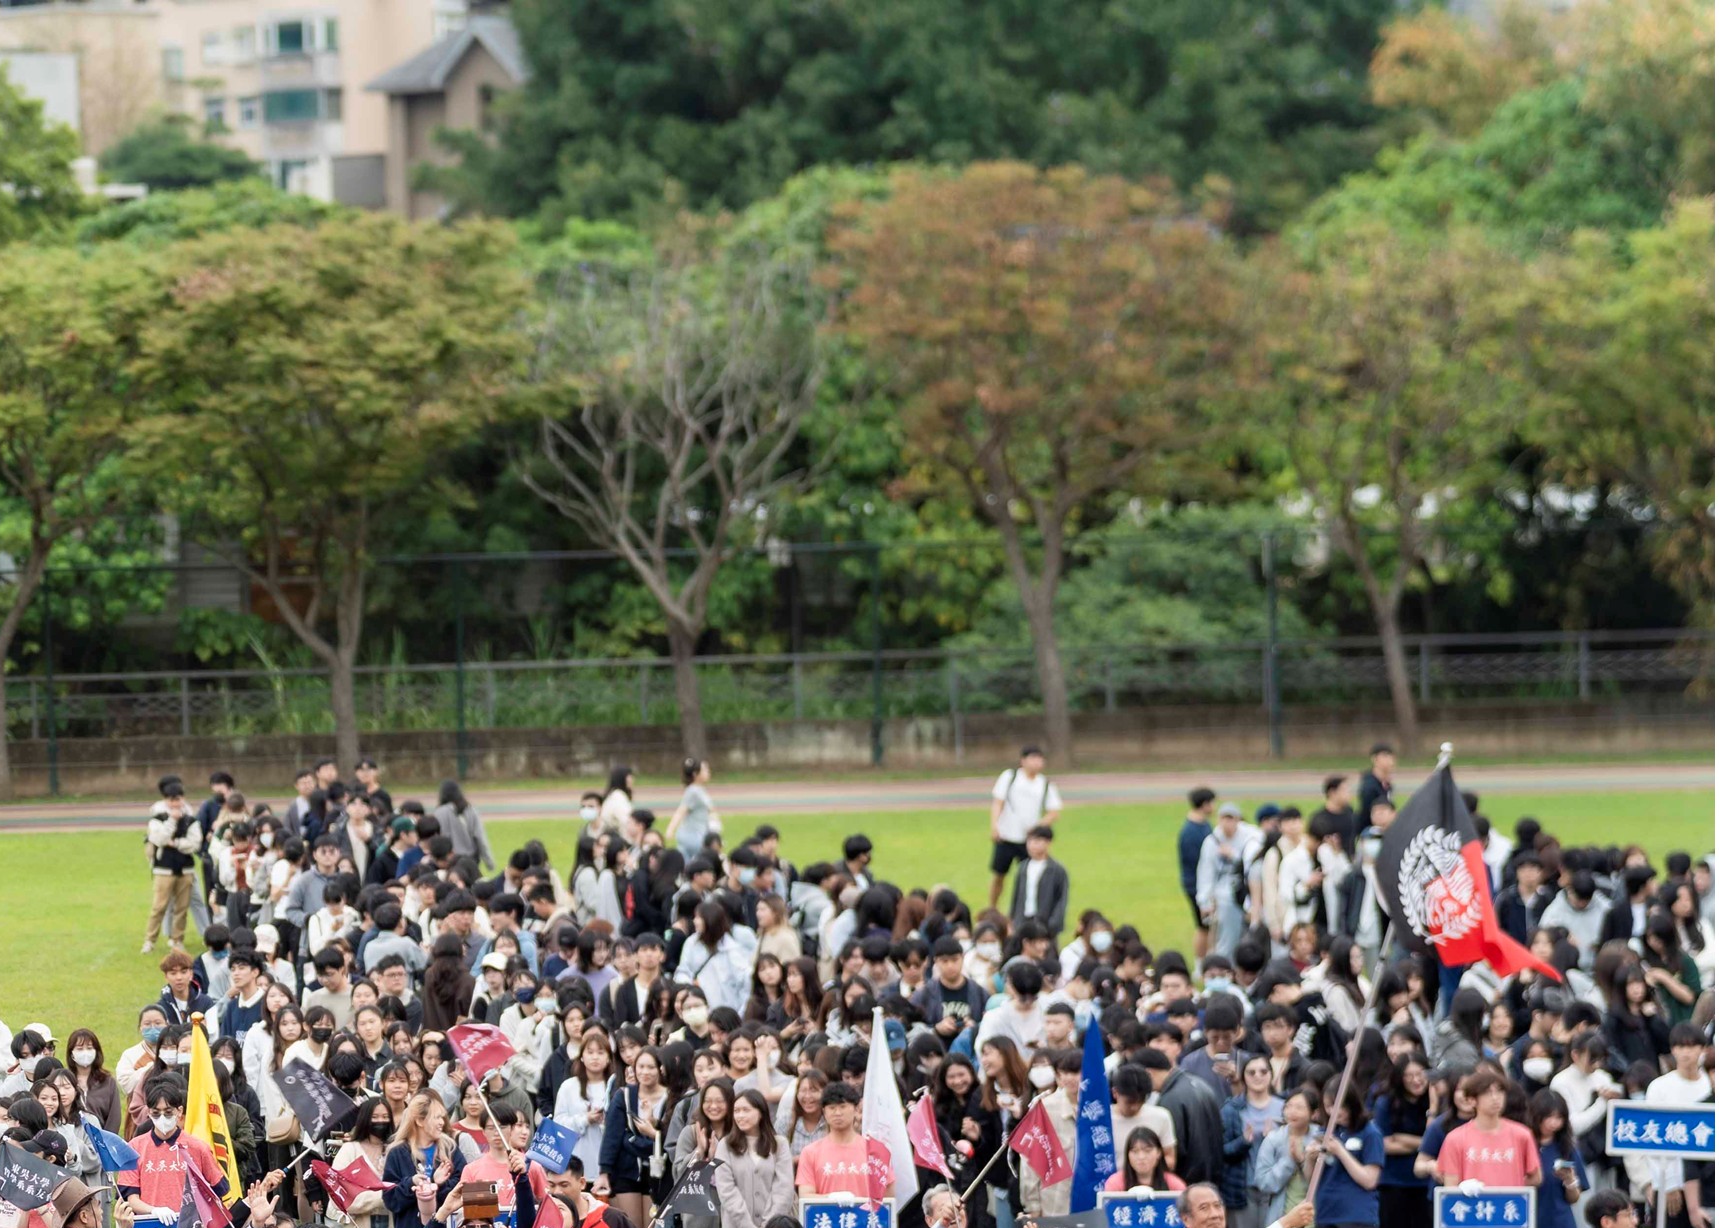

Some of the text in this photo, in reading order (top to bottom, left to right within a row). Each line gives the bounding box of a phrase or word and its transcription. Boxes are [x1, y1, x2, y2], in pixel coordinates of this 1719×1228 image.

[1614, 1118, 1714, 1147] 校友總會
[11, 1163, 51, 1188] 東吳大學
[1113, 1205, 1180, 1226] 經濟系
[1448, 1199, 1520, 1222] 會計系
